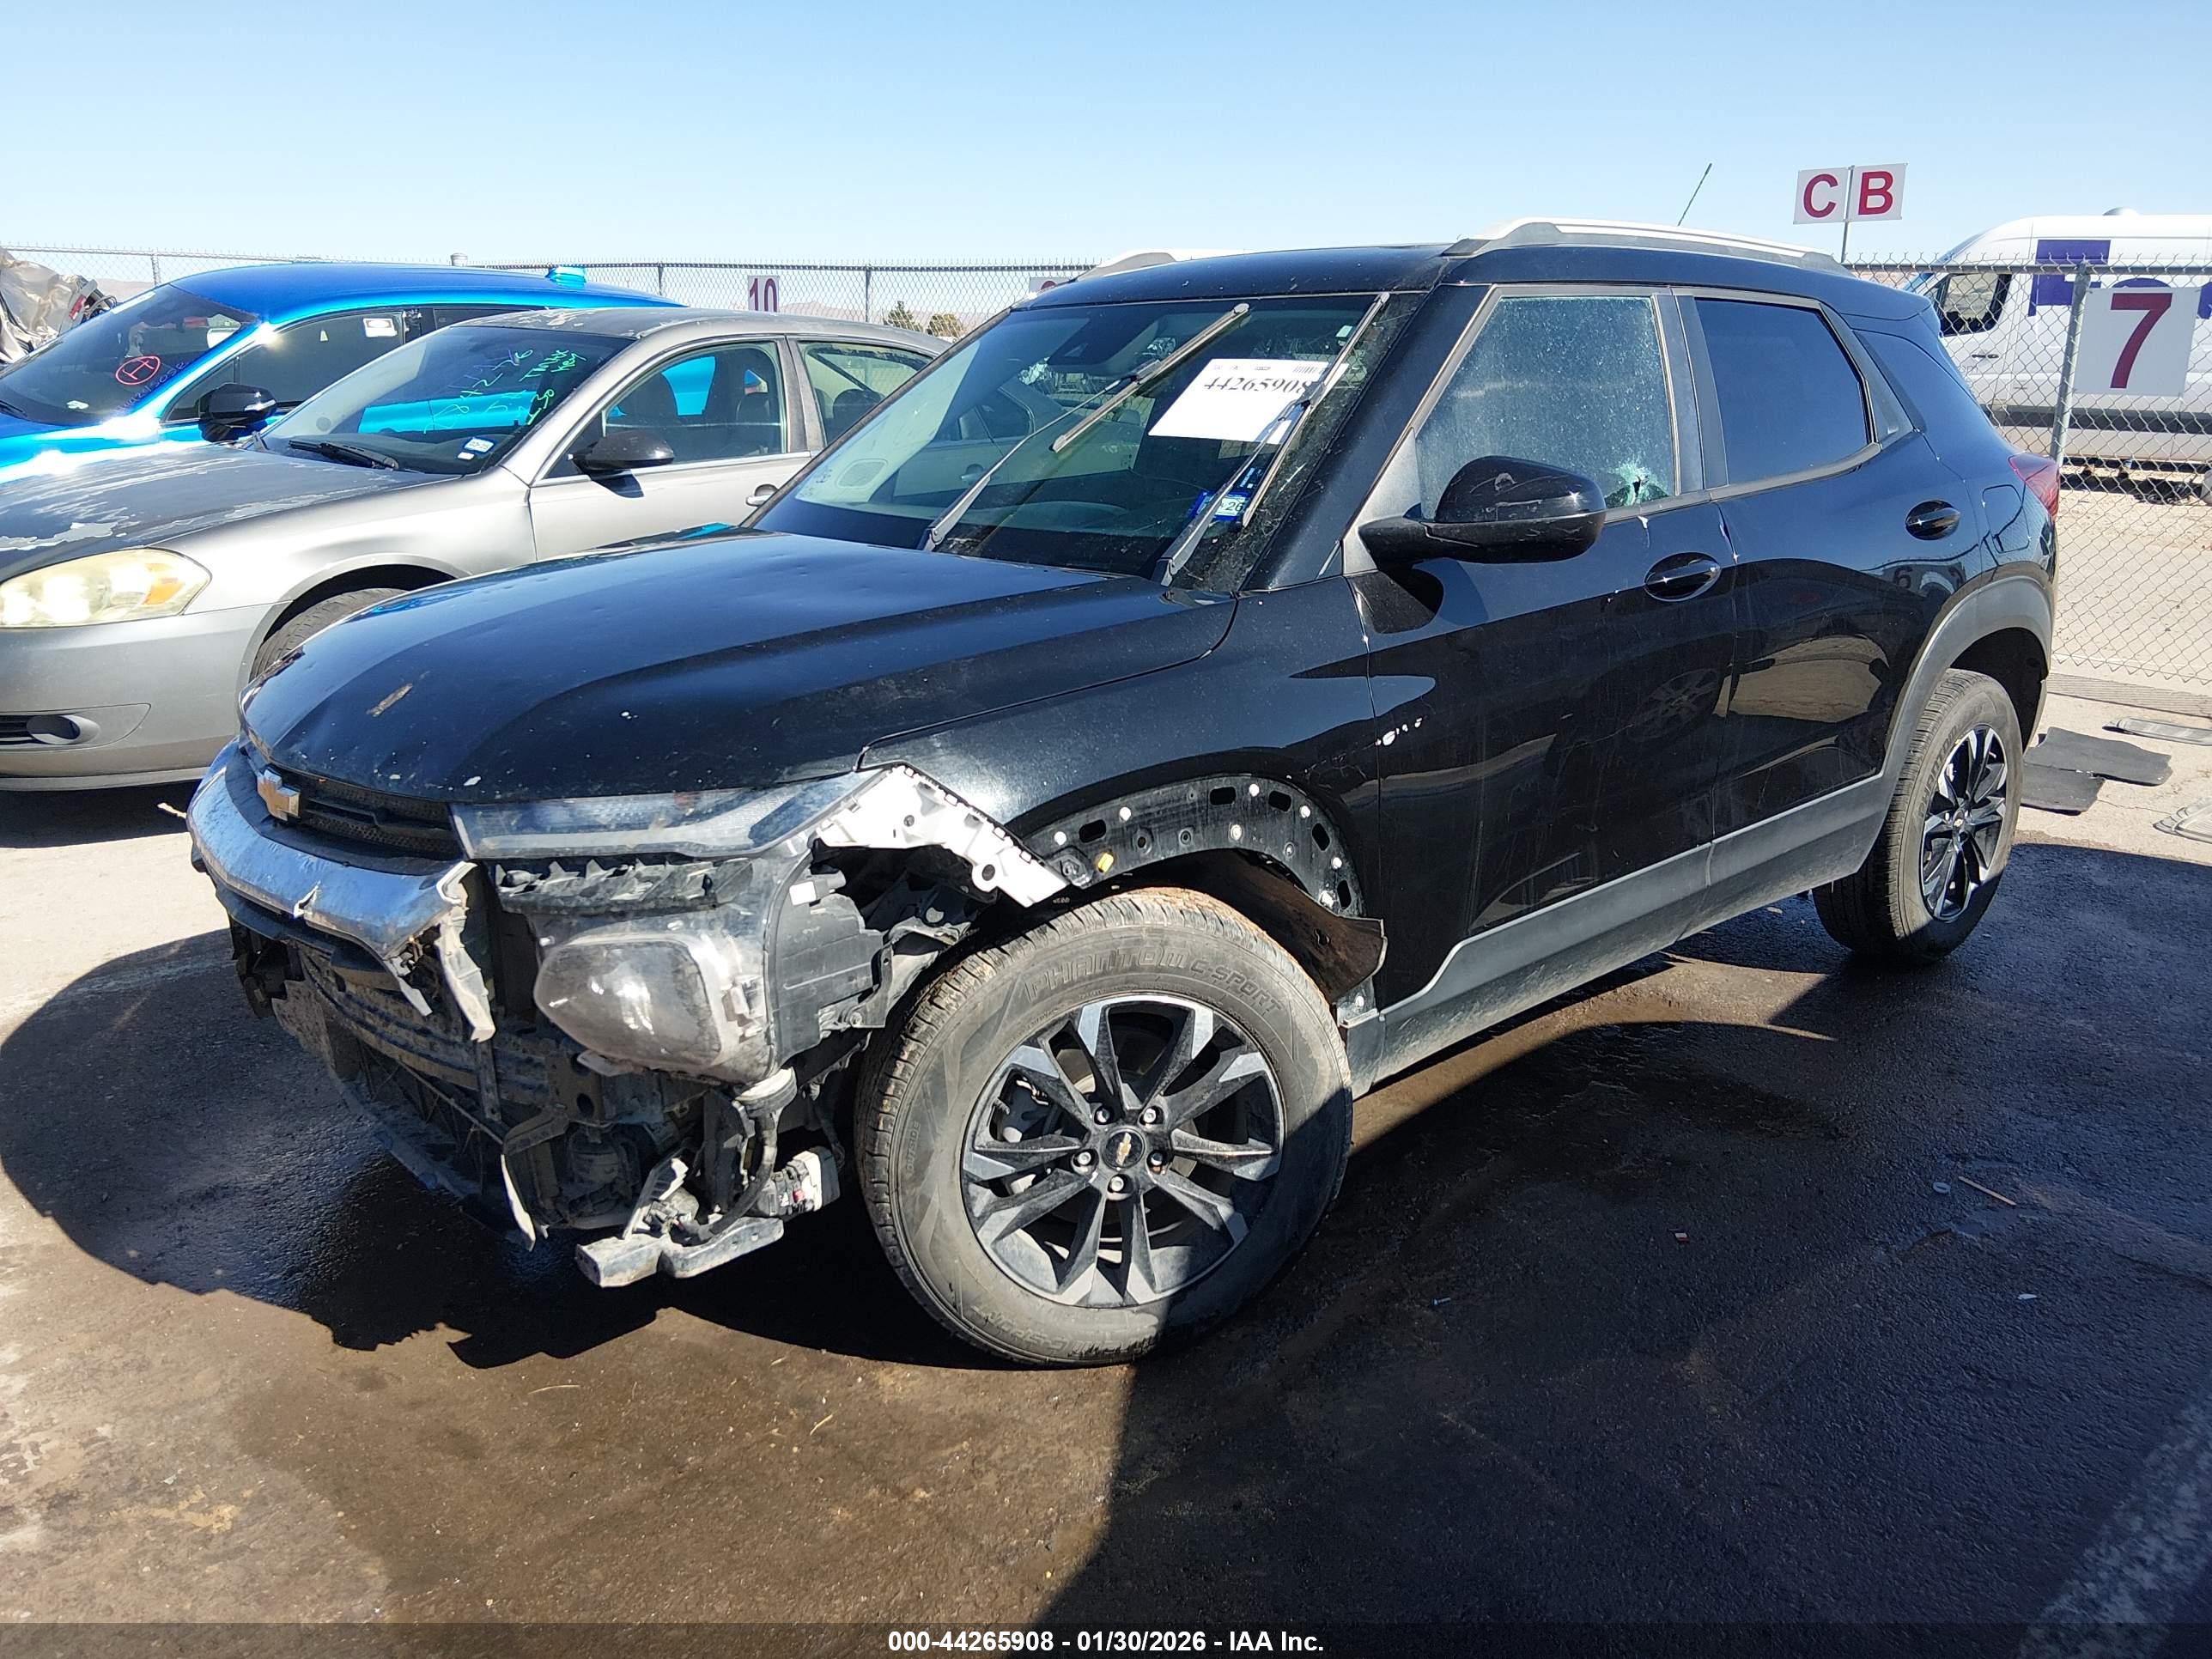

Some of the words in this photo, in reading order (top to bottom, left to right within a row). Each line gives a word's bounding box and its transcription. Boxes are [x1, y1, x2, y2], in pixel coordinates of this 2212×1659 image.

[1803, 173, 1838, 218] C
[1858, 171, 1893, 216] B
[750, 277, 777, 313] 10
[2110, 293, 2172, 388] 7
[1203, 376, 1307, 394] 44265908
[1022, 945, 1191, 1003] PHANTOM
[907, 1120, 921, 1176] OUTSIDE
